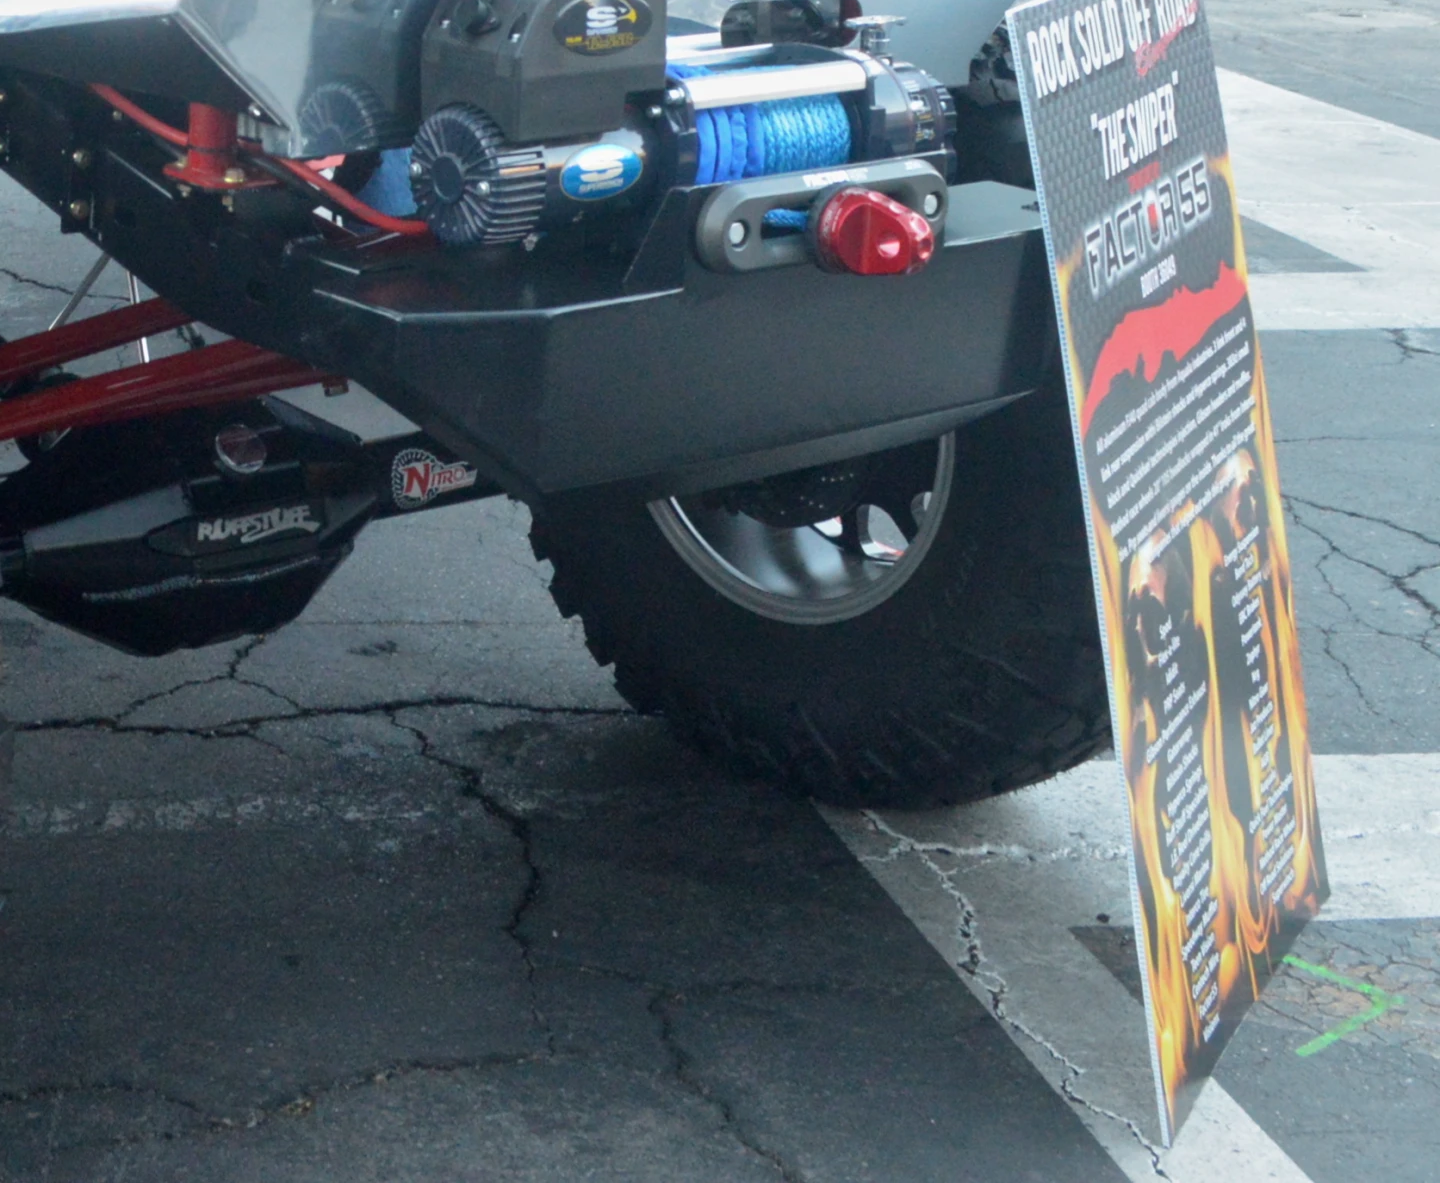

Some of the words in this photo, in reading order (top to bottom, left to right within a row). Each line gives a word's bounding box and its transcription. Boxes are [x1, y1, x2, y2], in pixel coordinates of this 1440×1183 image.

[1027, 19, 1080, 99] ROCK
[1084, 174, 1178, 298] FACTOR
[1176, 156, 1211, 232] 55
